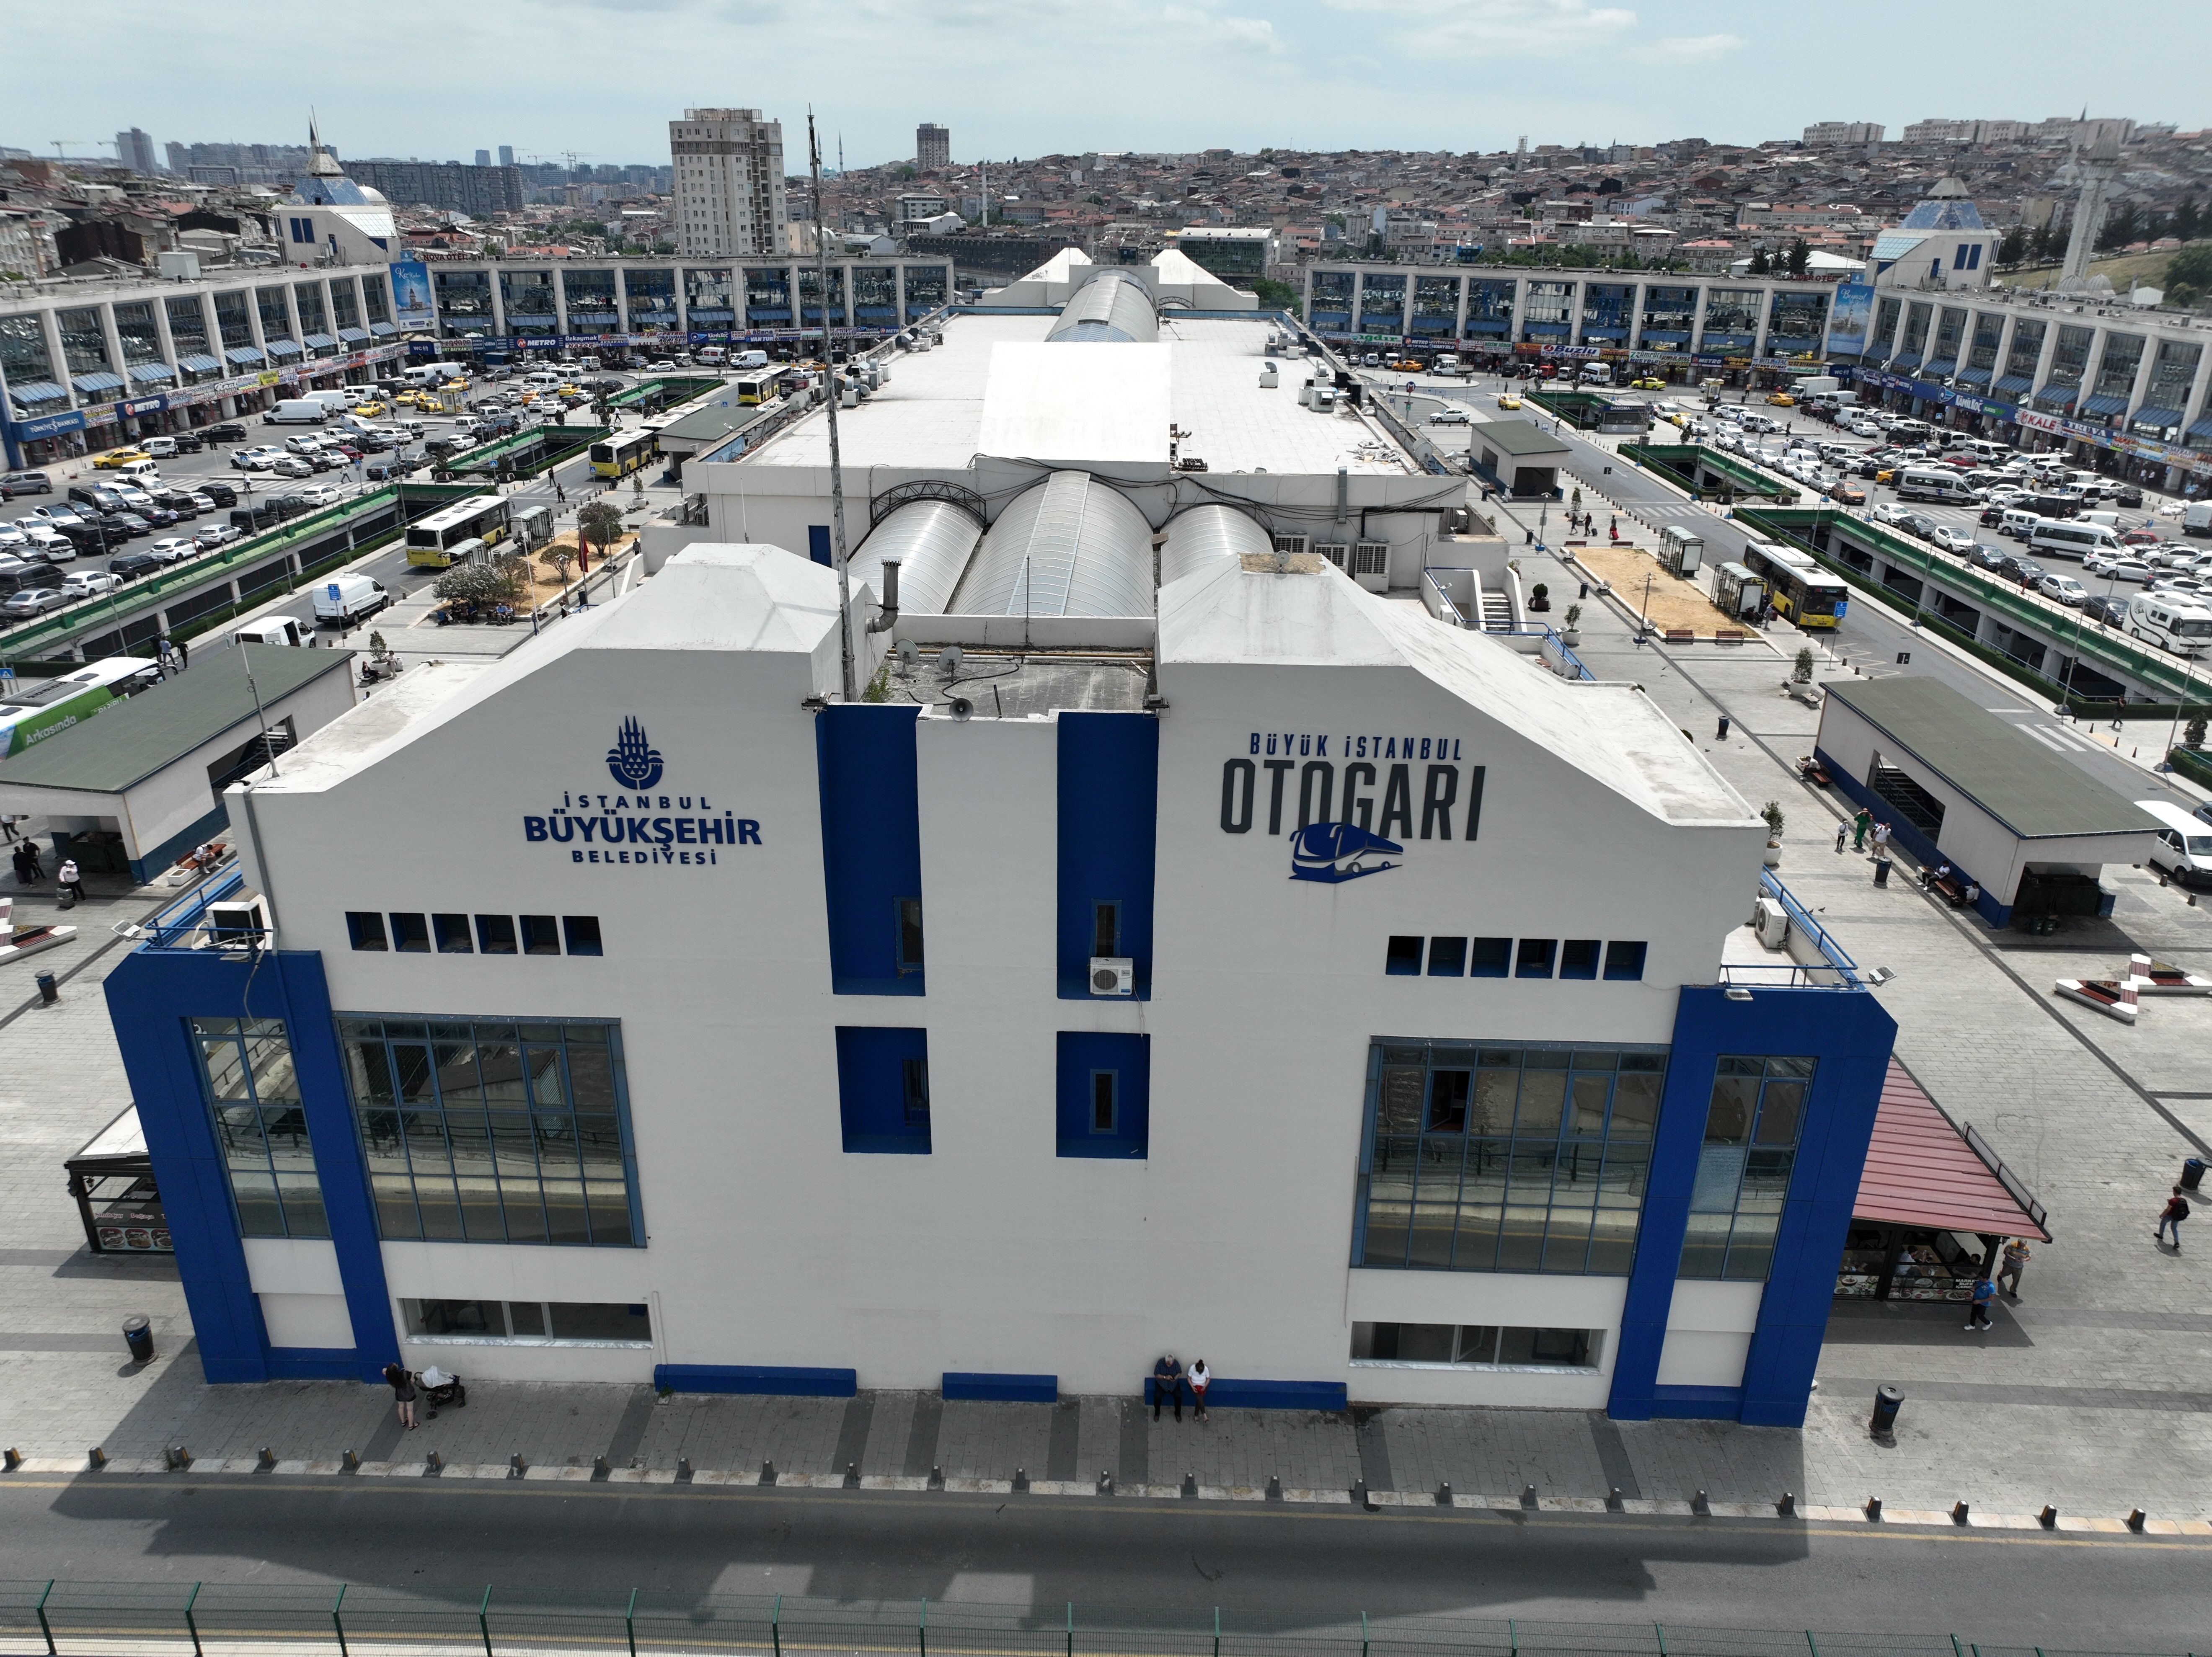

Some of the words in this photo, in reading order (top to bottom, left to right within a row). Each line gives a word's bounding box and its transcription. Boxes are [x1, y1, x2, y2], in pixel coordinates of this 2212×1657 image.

[1554, 345, 1597, 354] Buzlu
[134, 399, 160, 413] METRO
[57, 418, 79, 428] BANKASI
[2027, 415, 2057, 431] KALE
[2068, 421, 2106, 437] TRUVA
[26, 715, 77, 746] Arkasında
[1250, 733, 1328, 757] BÜYÜK
[1345, 736, 1462, 760] İSTANBUL
[564, 791, 711, 810] İSTANBUL
[1220, 758, 1486, 841] OTOGARI
[524, 808, 762, 851] BÜYÜKŞEHİR
[571, 848, 716, 865] BELEDİYESİ
